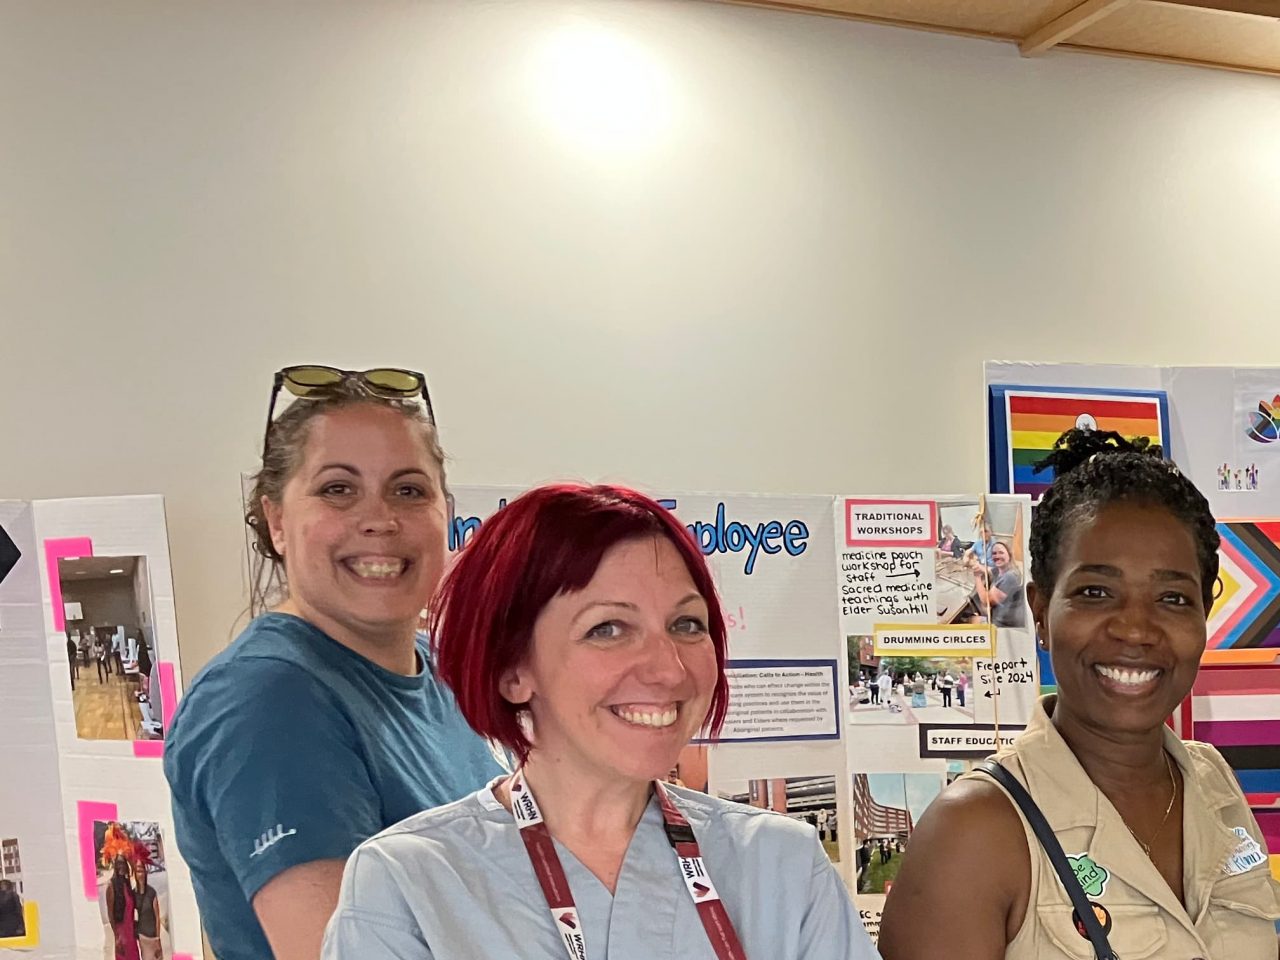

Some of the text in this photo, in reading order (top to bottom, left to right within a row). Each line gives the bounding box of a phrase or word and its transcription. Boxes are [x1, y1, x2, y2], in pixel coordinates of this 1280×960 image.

[855, 513, 924, 521] TRADITIONAL
[857, 526, 923, 534] WORKSHOPS
[842, 550, 923, 563] medicine pouch
[900, 560, 920, 570] for
[842, 582, 933, 595] Sacred medicine
[842, 595, 899, 607] teachings
[843, 606, 872, 615] Elder
[883, 635, 986, 644] DRUMMING CIRLCES
[977, 657, 1028, 674] Freeport
[1008, 671, 1034, 684] 2024
[932, 737, 962, 745] STAFF
[520, 791, 538, 820] WRHN
[1080, 865, 1099, 886] ind
